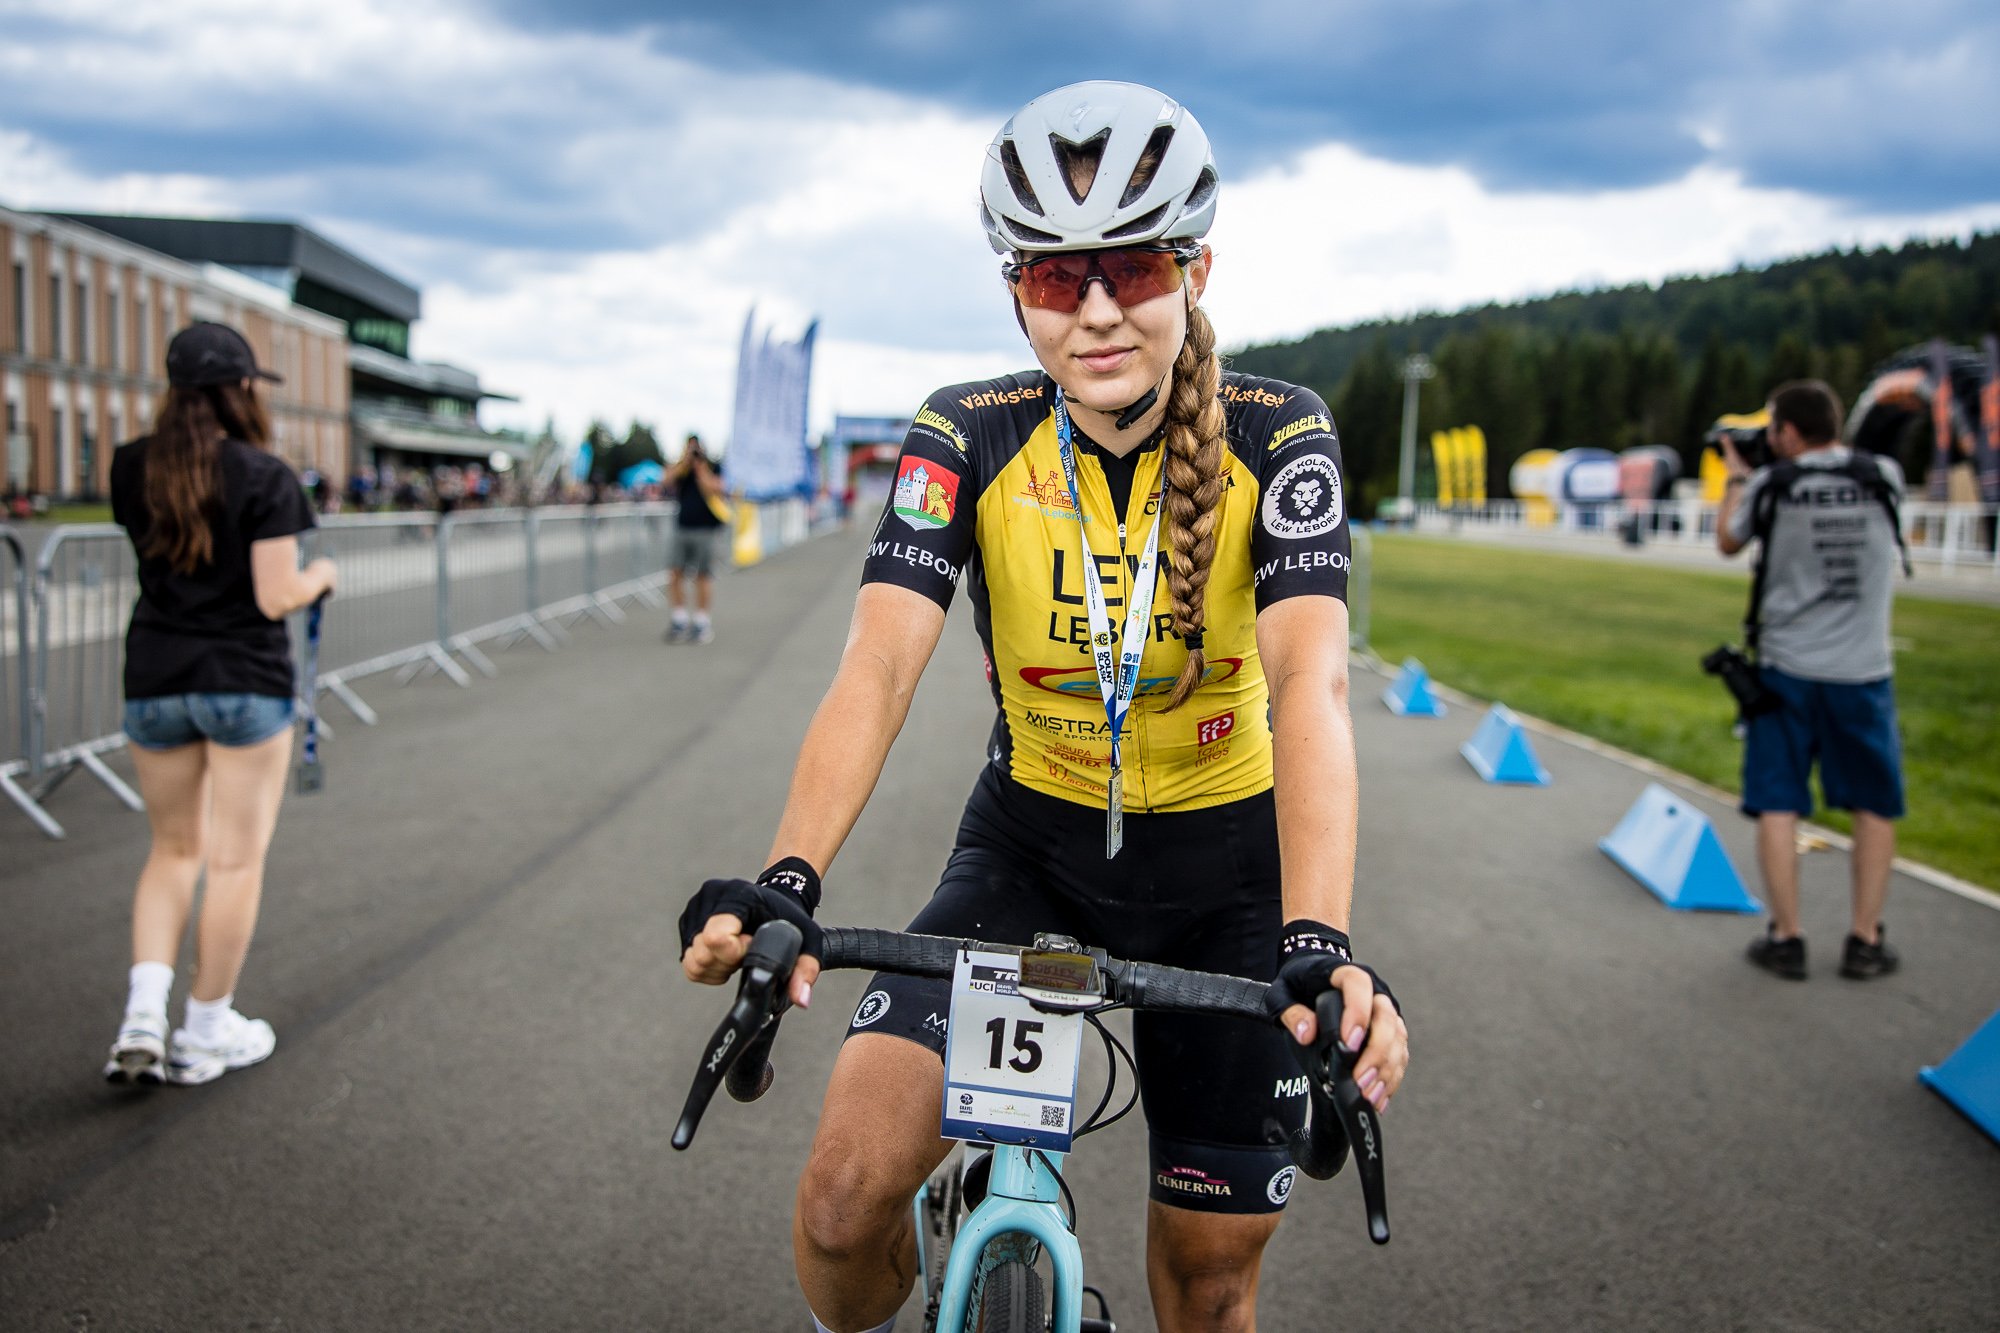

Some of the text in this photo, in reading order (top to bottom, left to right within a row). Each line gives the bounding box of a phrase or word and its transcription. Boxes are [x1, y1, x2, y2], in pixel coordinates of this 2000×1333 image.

[1269, 459, 1339, 496] KLUB KOLARSKI
[1270, 512, 1338, 534] LEW LĘBORK
[892, 542, 960, 587] LĘBOR
[1254, 551, 1351, 588] EW LĘBOR
[1103, 651, 1113, 685] DOLNY
[1027, 720, 1059, 736] SALON
[1044, 744, 1102, 768] SPORTEX
[1054, 742, 1092, 757] GRUPA
[974, 982, 994, 992] UCI
[993, 970, 1018, 981] TR
[706, 1028, 737, 1073] GRX
[986, 1017, 1044, 1074] 15
[1274, 1075, 1309, 1098] MAR
[1358, 1111, 1377, 1160] GRX
[1157, 1174, 1232, 1195] CUKIERNIA
